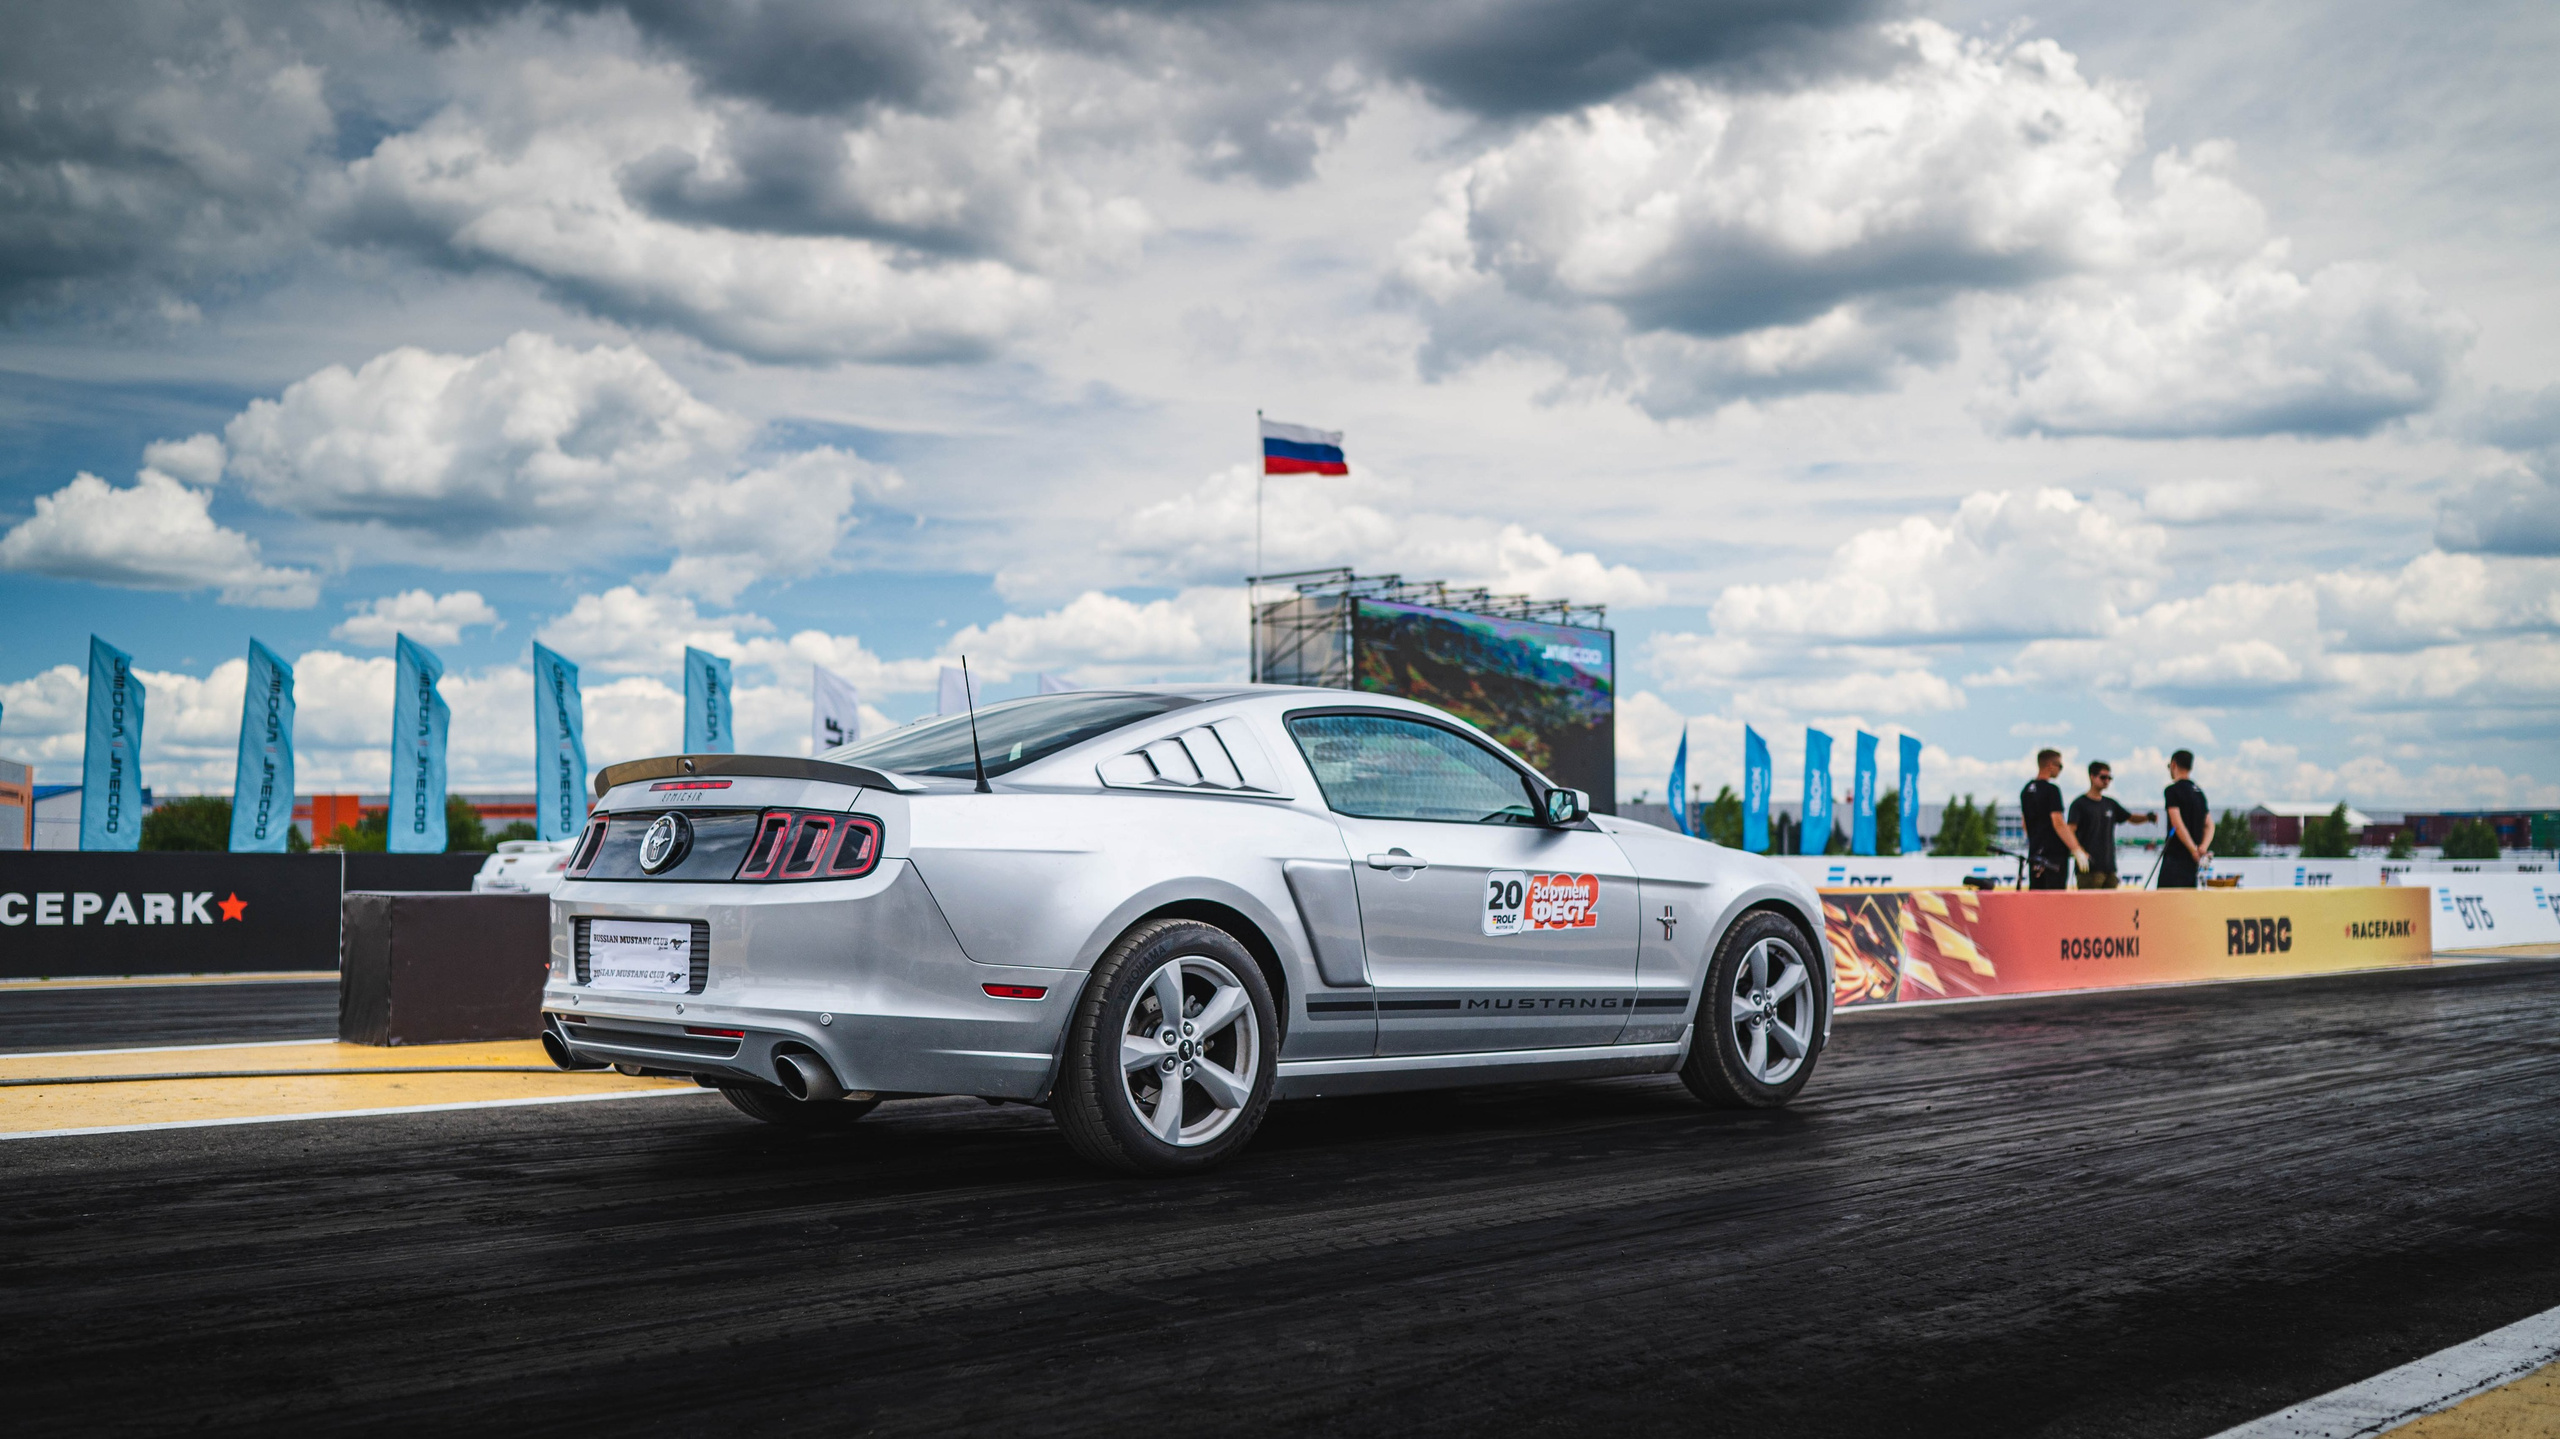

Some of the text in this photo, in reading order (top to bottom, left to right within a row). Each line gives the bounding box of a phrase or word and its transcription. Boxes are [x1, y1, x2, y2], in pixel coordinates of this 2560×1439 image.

[825, 716, 844, 750] LF
[1488, 880, 1523, 910] 20
[0, 892, 214, 926] CEPARK
[1496, 914, 1517, 925] ROLF
[1531, 900, 1590, 923] ФЕСТ
[2455, 895, 2495, 931] ВТБ
[593, 933, 669, 946] RUSSIAN MUSTANG CLUB
[2226, 916, 2292, 957] RDRC
[2351, 919, 2412, 941] RACEPARK
[2060, 936, 2140, 961] ROSGONKI
[616, 970, 648, 979] MUSTANG
[649, 971, 665, 979] CLUB
[1116, 944, 1168, 1001] YOKOHAMA
[1467, 998, 1617, 1010] MUSTANG
